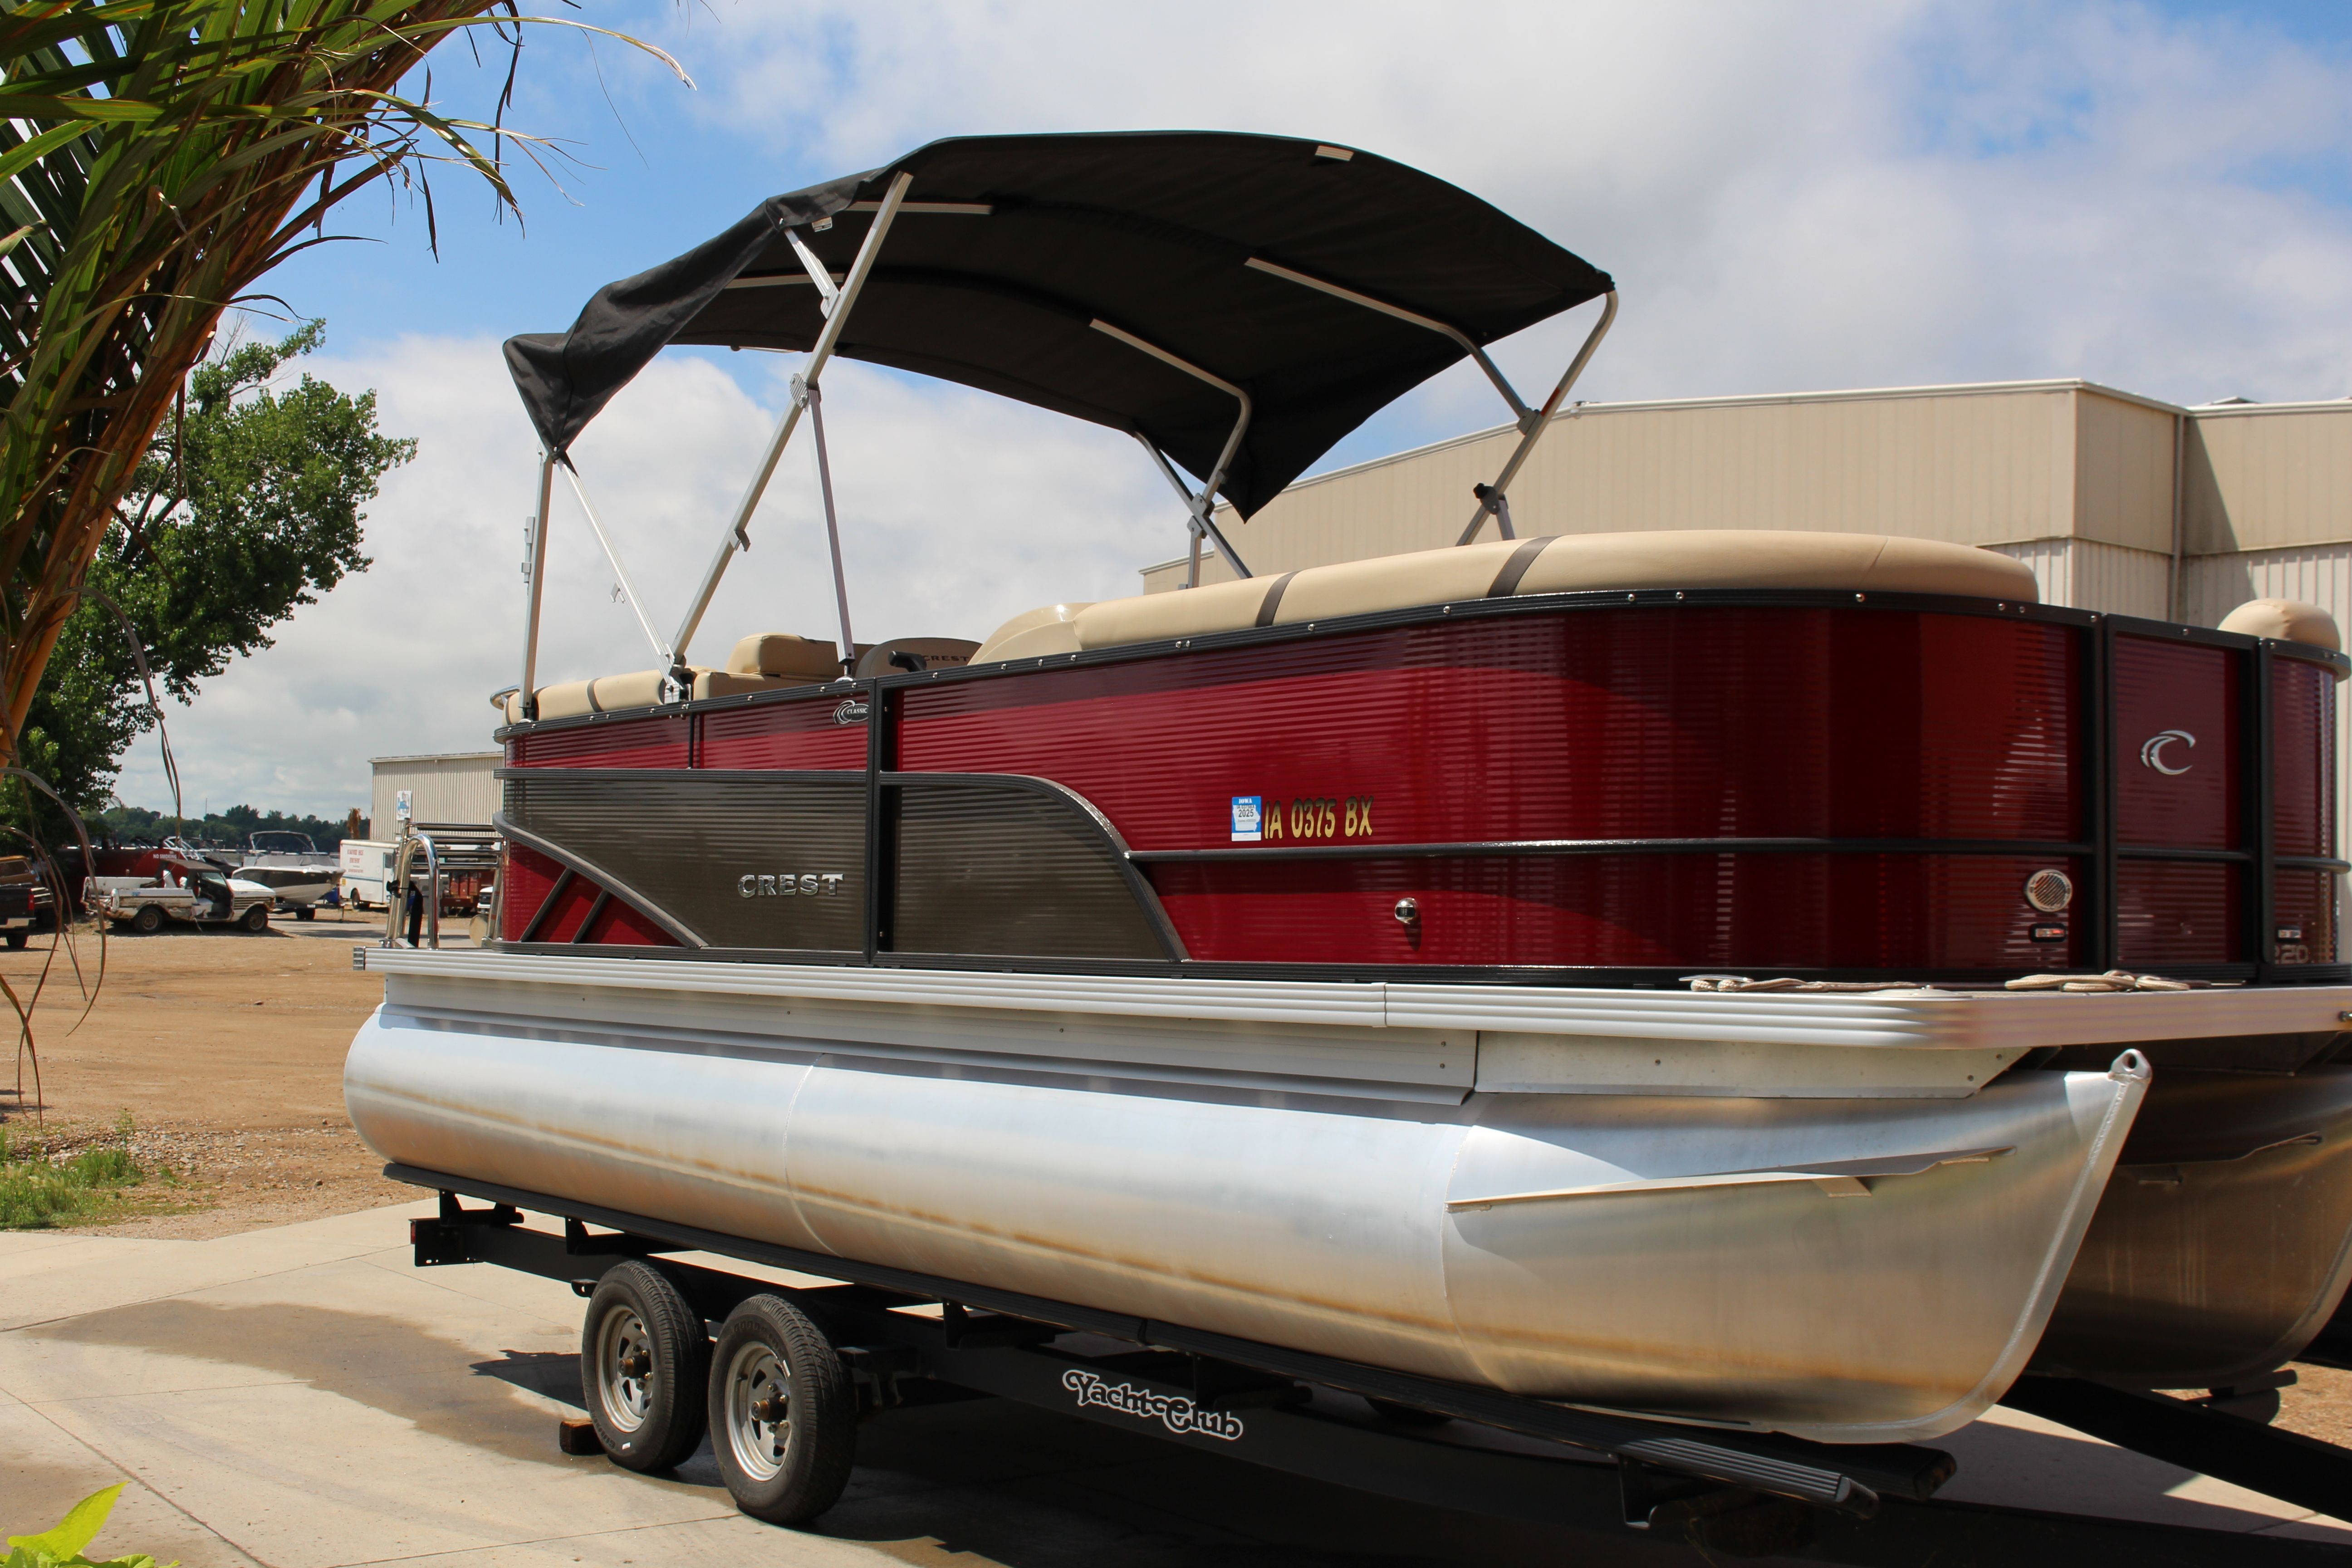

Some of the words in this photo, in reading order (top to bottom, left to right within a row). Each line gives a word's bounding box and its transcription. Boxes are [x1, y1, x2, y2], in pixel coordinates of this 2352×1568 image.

[1238, 809, 1254, 817] 2025
[1264, 800, 1283, 839] IA
[1291, 797, 1337, 838] 0375
[1344, 795, 1374, 837] BX
[737, 873, 844, 898] CREST
